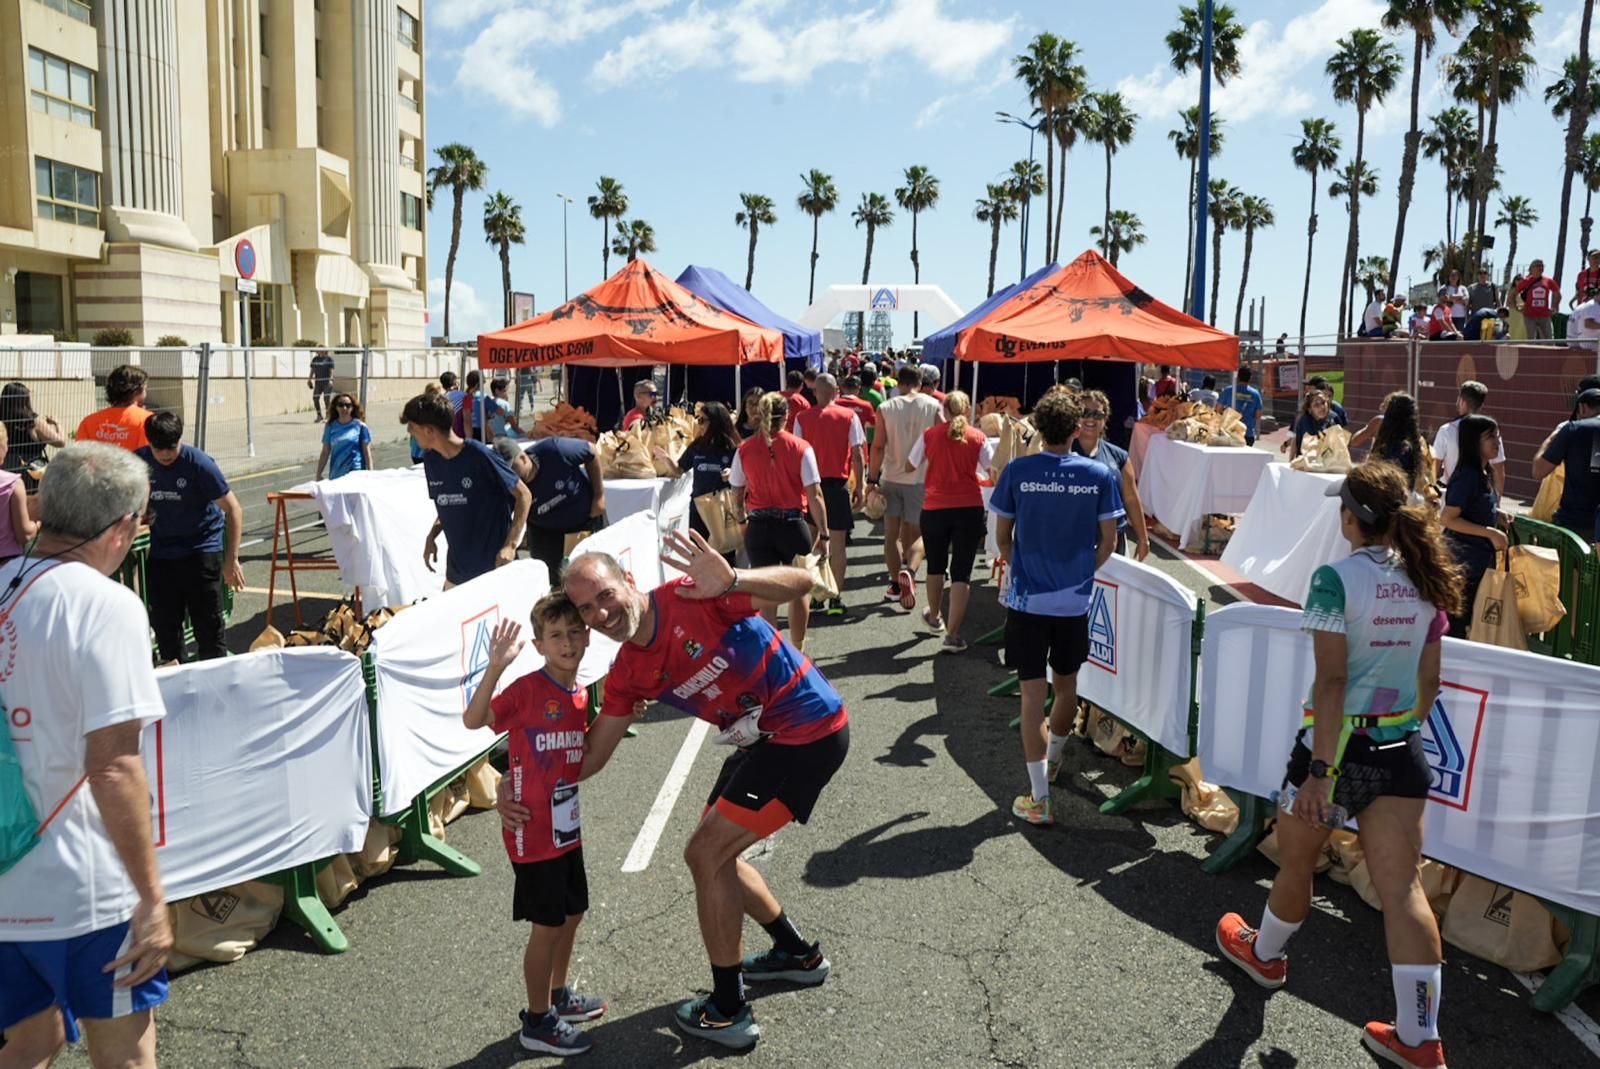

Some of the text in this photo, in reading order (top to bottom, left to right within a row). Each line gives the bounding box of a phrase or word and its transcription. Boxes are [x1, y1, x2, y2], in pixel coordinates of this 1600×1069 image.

[488, 340, 594, 364] DGEVENTOS.COM
[995, 335, 1017, 358] dg
[1068, 484, 1099, 495] sport
[1089, 640, 1112, 664] ALDI
